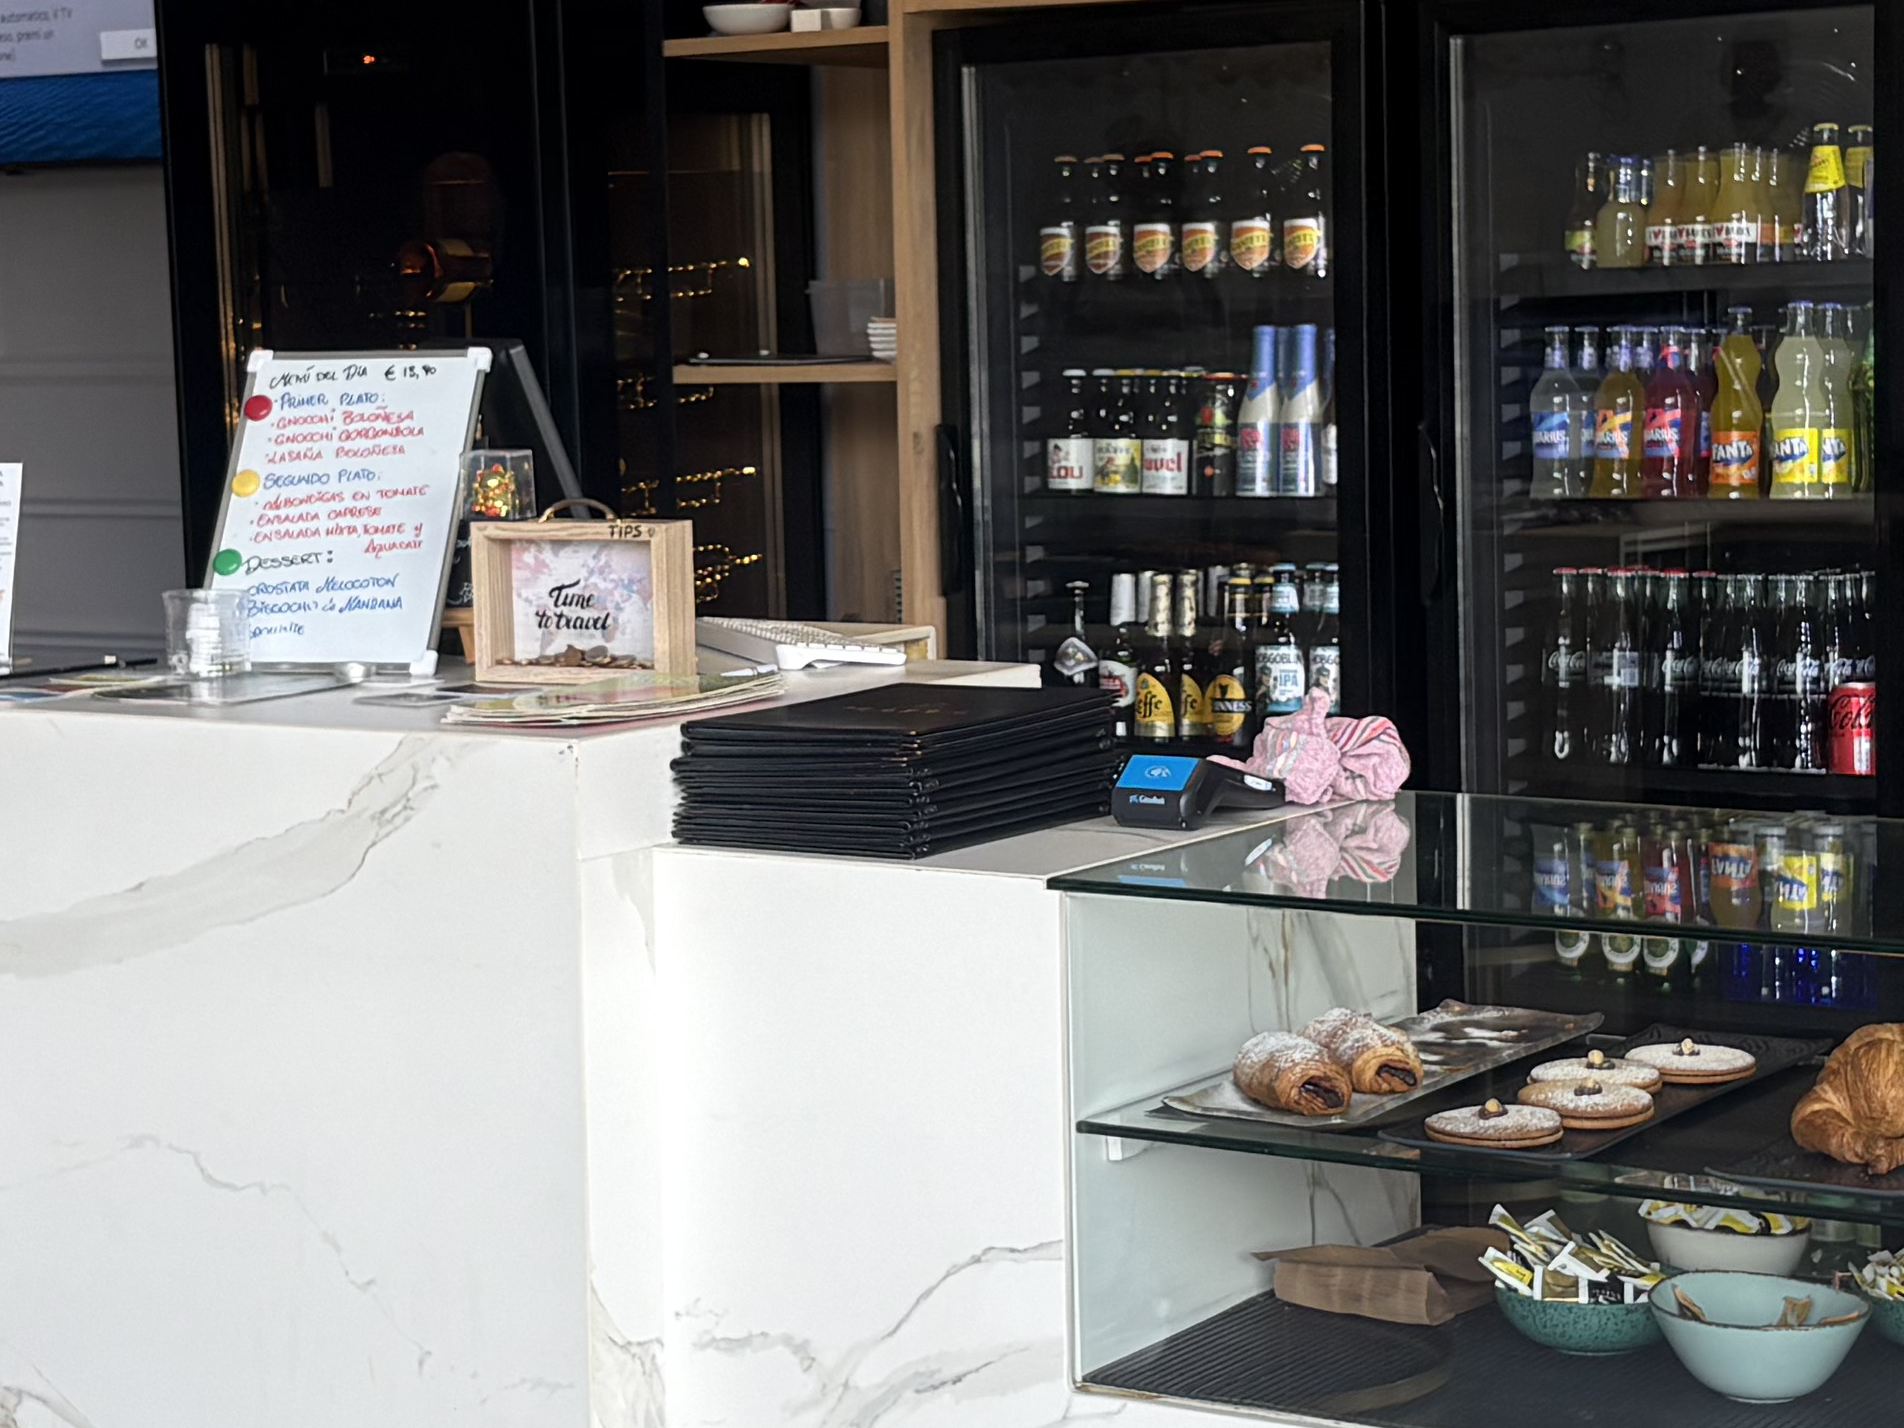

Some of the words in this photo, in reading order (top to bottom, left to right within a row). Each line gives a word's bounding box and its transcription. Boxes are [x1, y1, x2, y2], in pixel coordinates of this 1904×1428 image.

[548, 578, 596, 609] Time
[1279, 671, 1299, 687] IPA
[1135, 692, 1164, 719] effe
